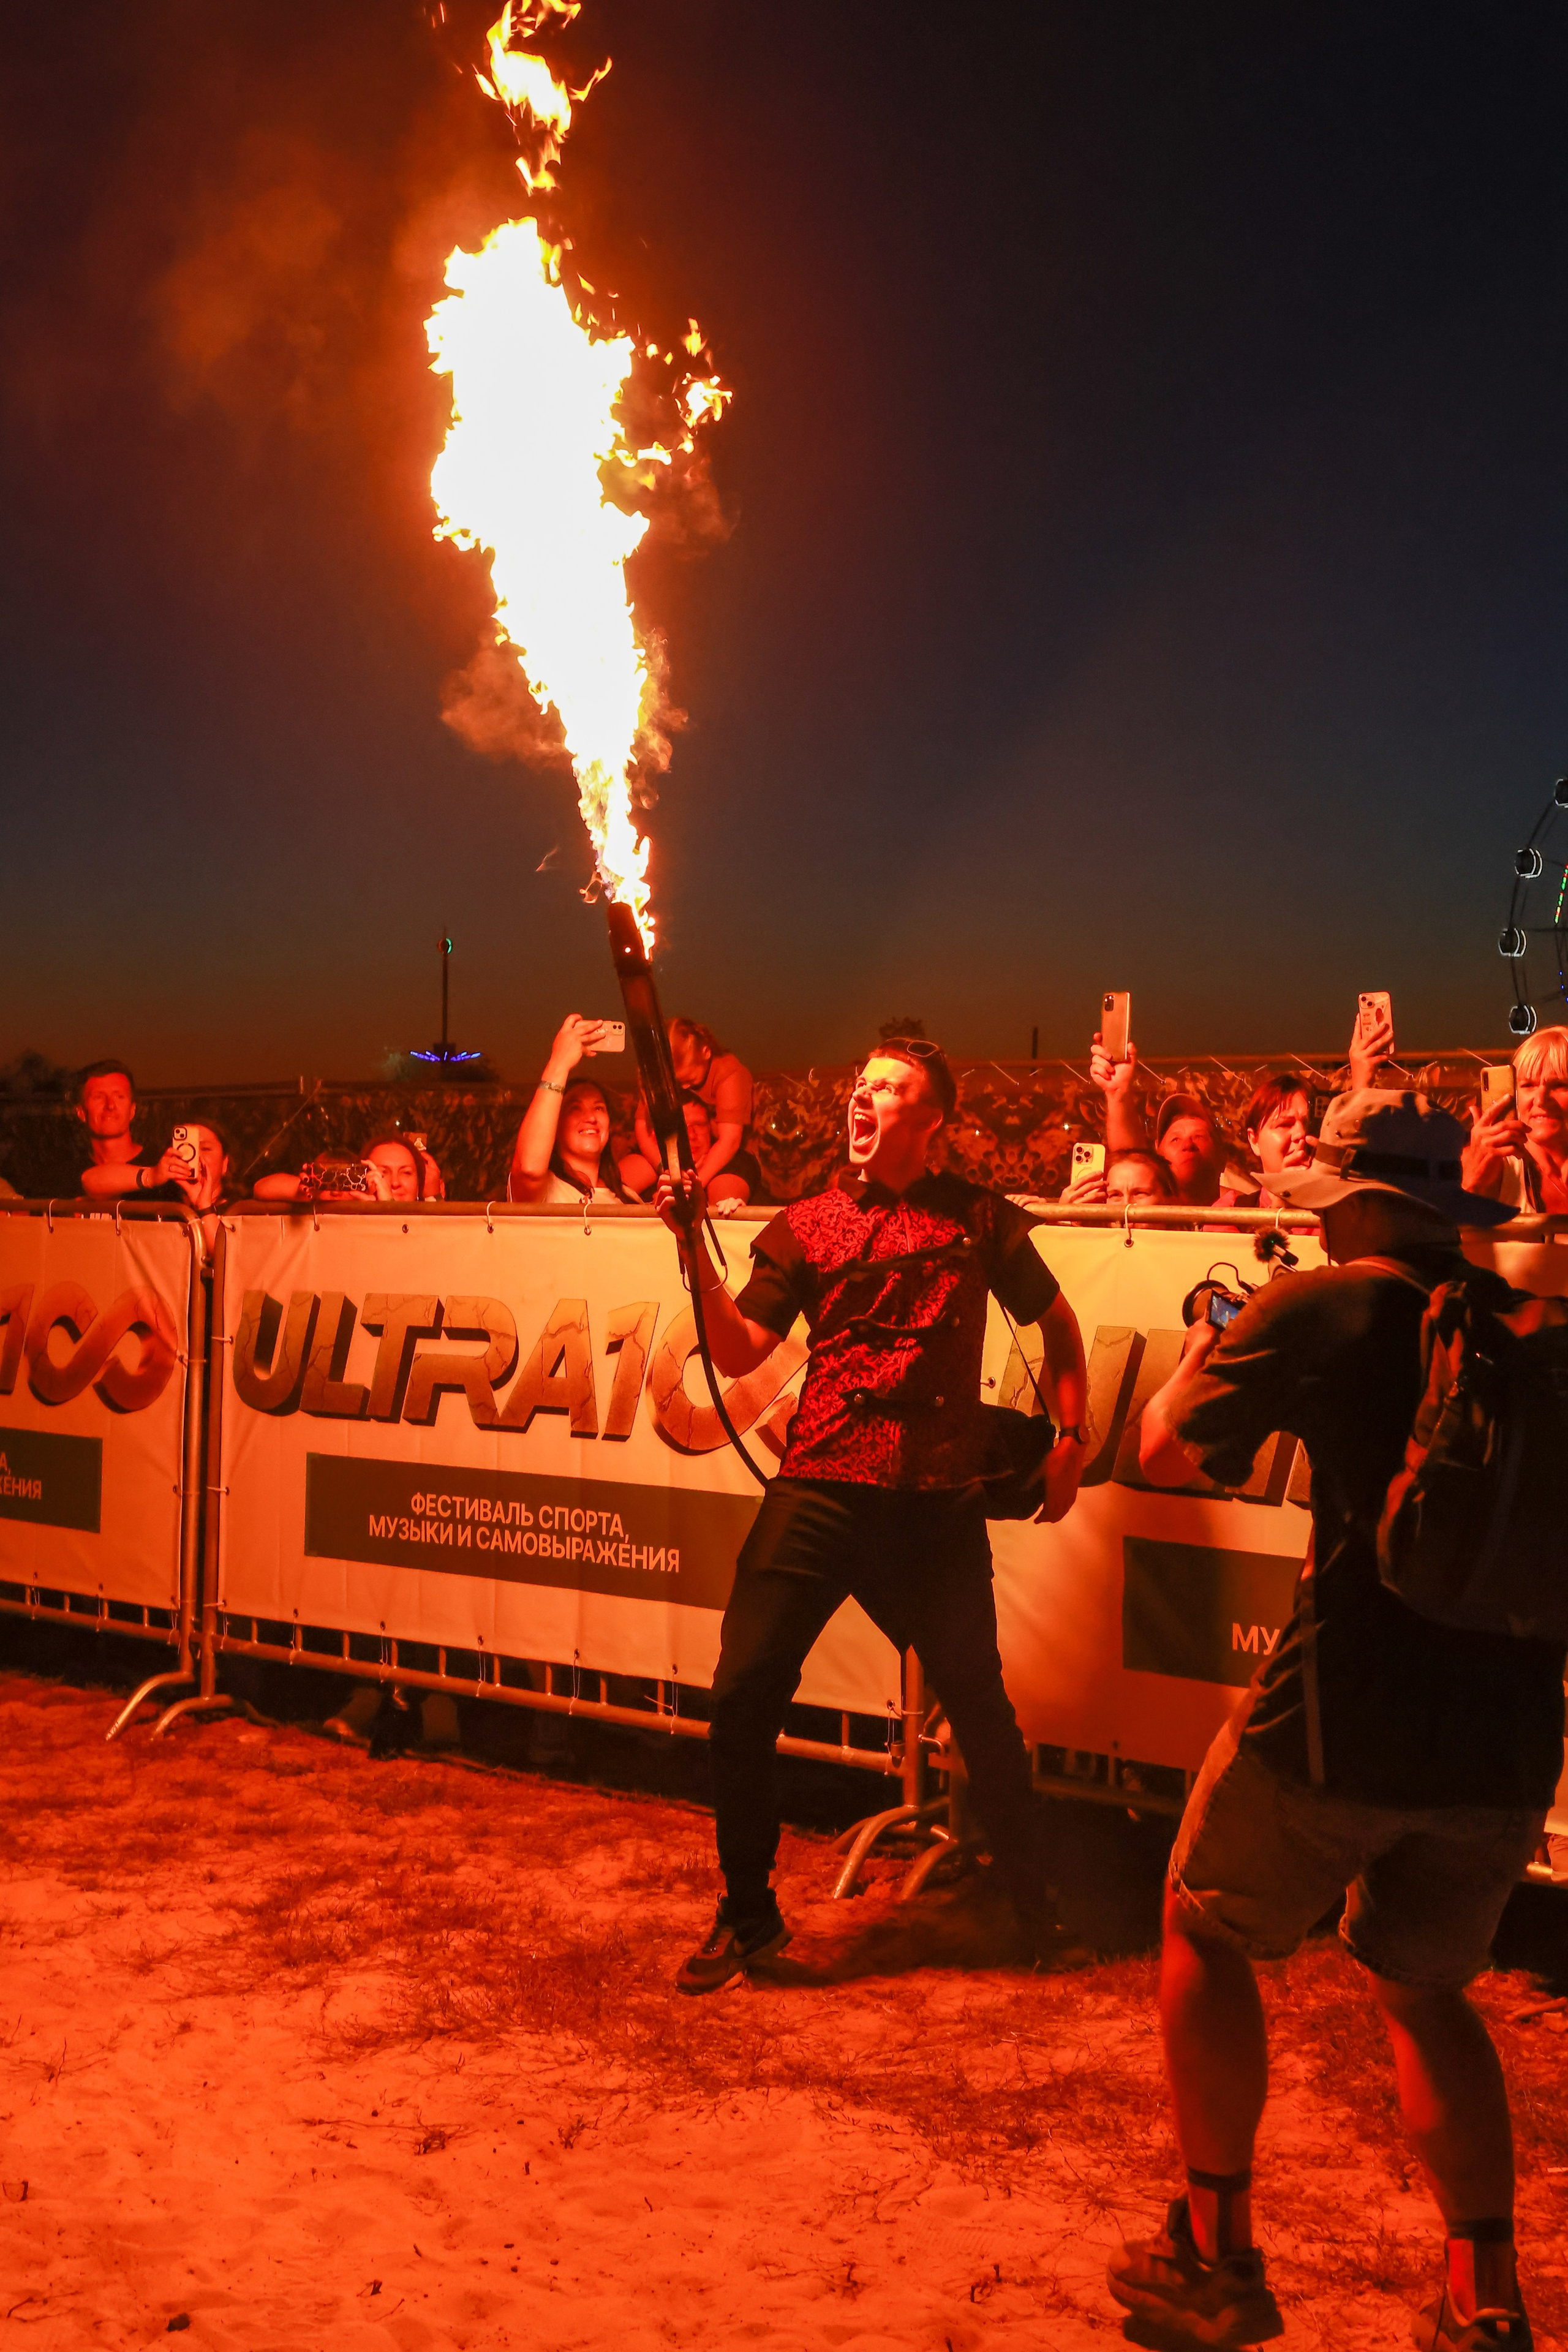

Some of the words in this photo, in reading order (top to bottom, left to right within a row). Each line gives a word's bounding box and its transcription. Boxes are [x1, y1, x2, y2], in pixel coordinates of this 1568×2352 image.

[0, 1476, 42, 1499] ЕНИЯ
[411, 1492, 533, 1526] ФЕСТИВАЛЬ
[539, 1505, 629, 1544] СПОРТА,
[369, 1515, 453, 1545] МУЗЫКИ
[458, 1524, 471, 1547] И
[476, 1526, 679, 1573] САМОВЫРАЖЕНИЯ
[1232, 1623, 1280, 1656] МУ
